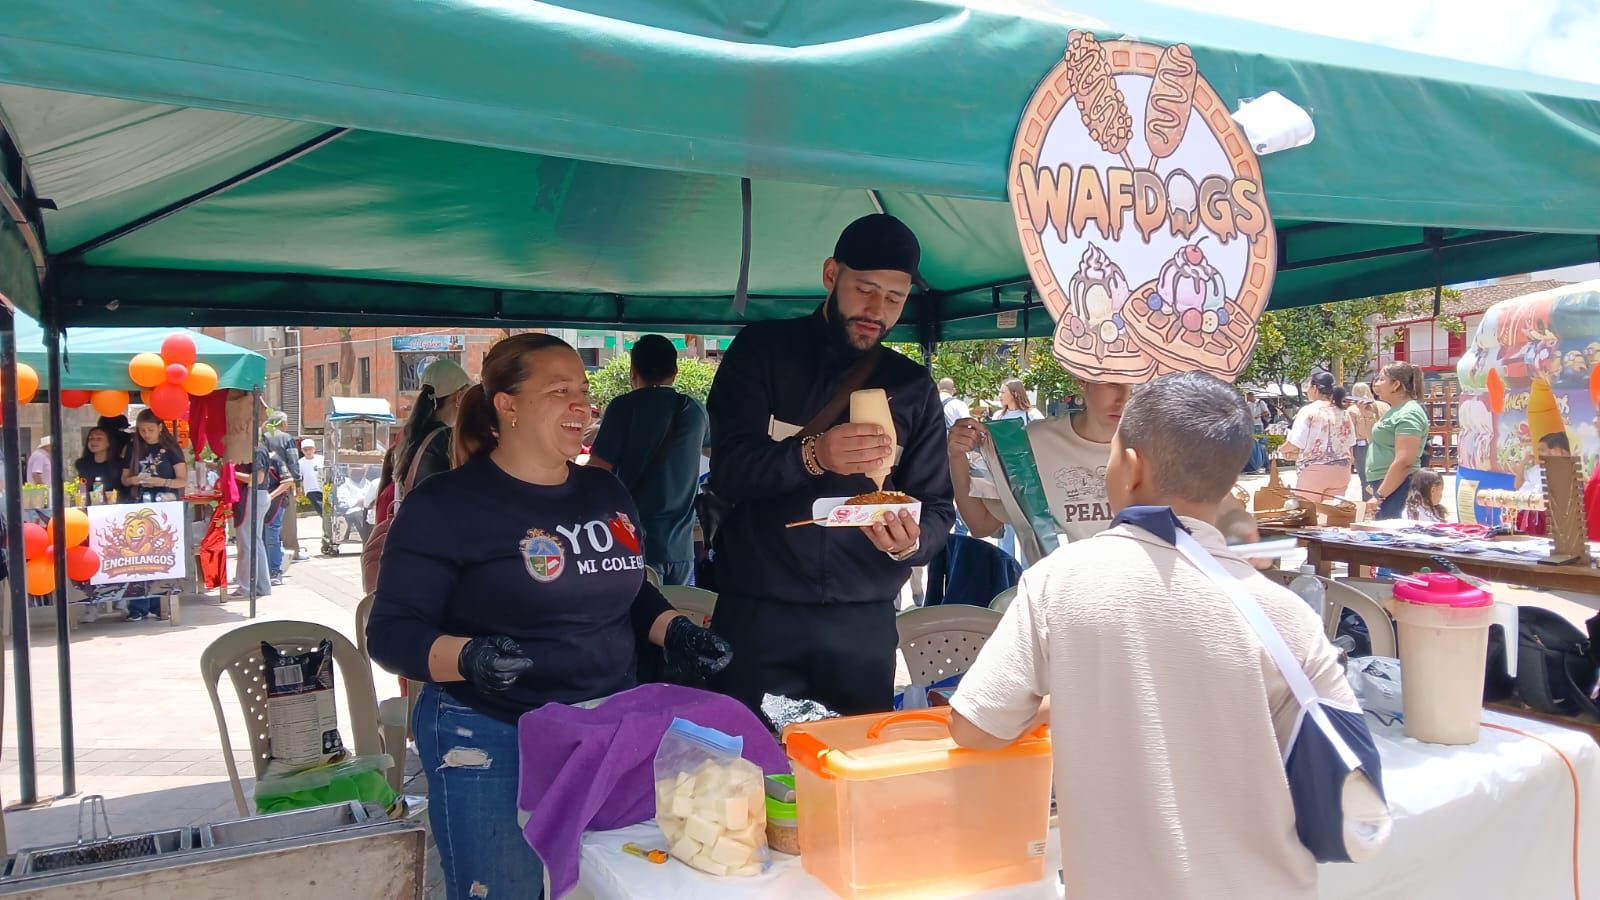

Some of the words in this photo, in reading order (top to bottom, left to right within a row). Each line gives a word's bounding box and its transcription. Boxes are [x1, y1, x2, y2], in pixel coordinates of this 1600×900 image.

[1019, 162, 1266, 244] WAFDOGS
[1503, 391, 1529, 413] ANGR
[555, 520, 614, 555] YO
[103, 555, 174, 571] ENCHILANGOS
[577, 559, 598, 575] MI
